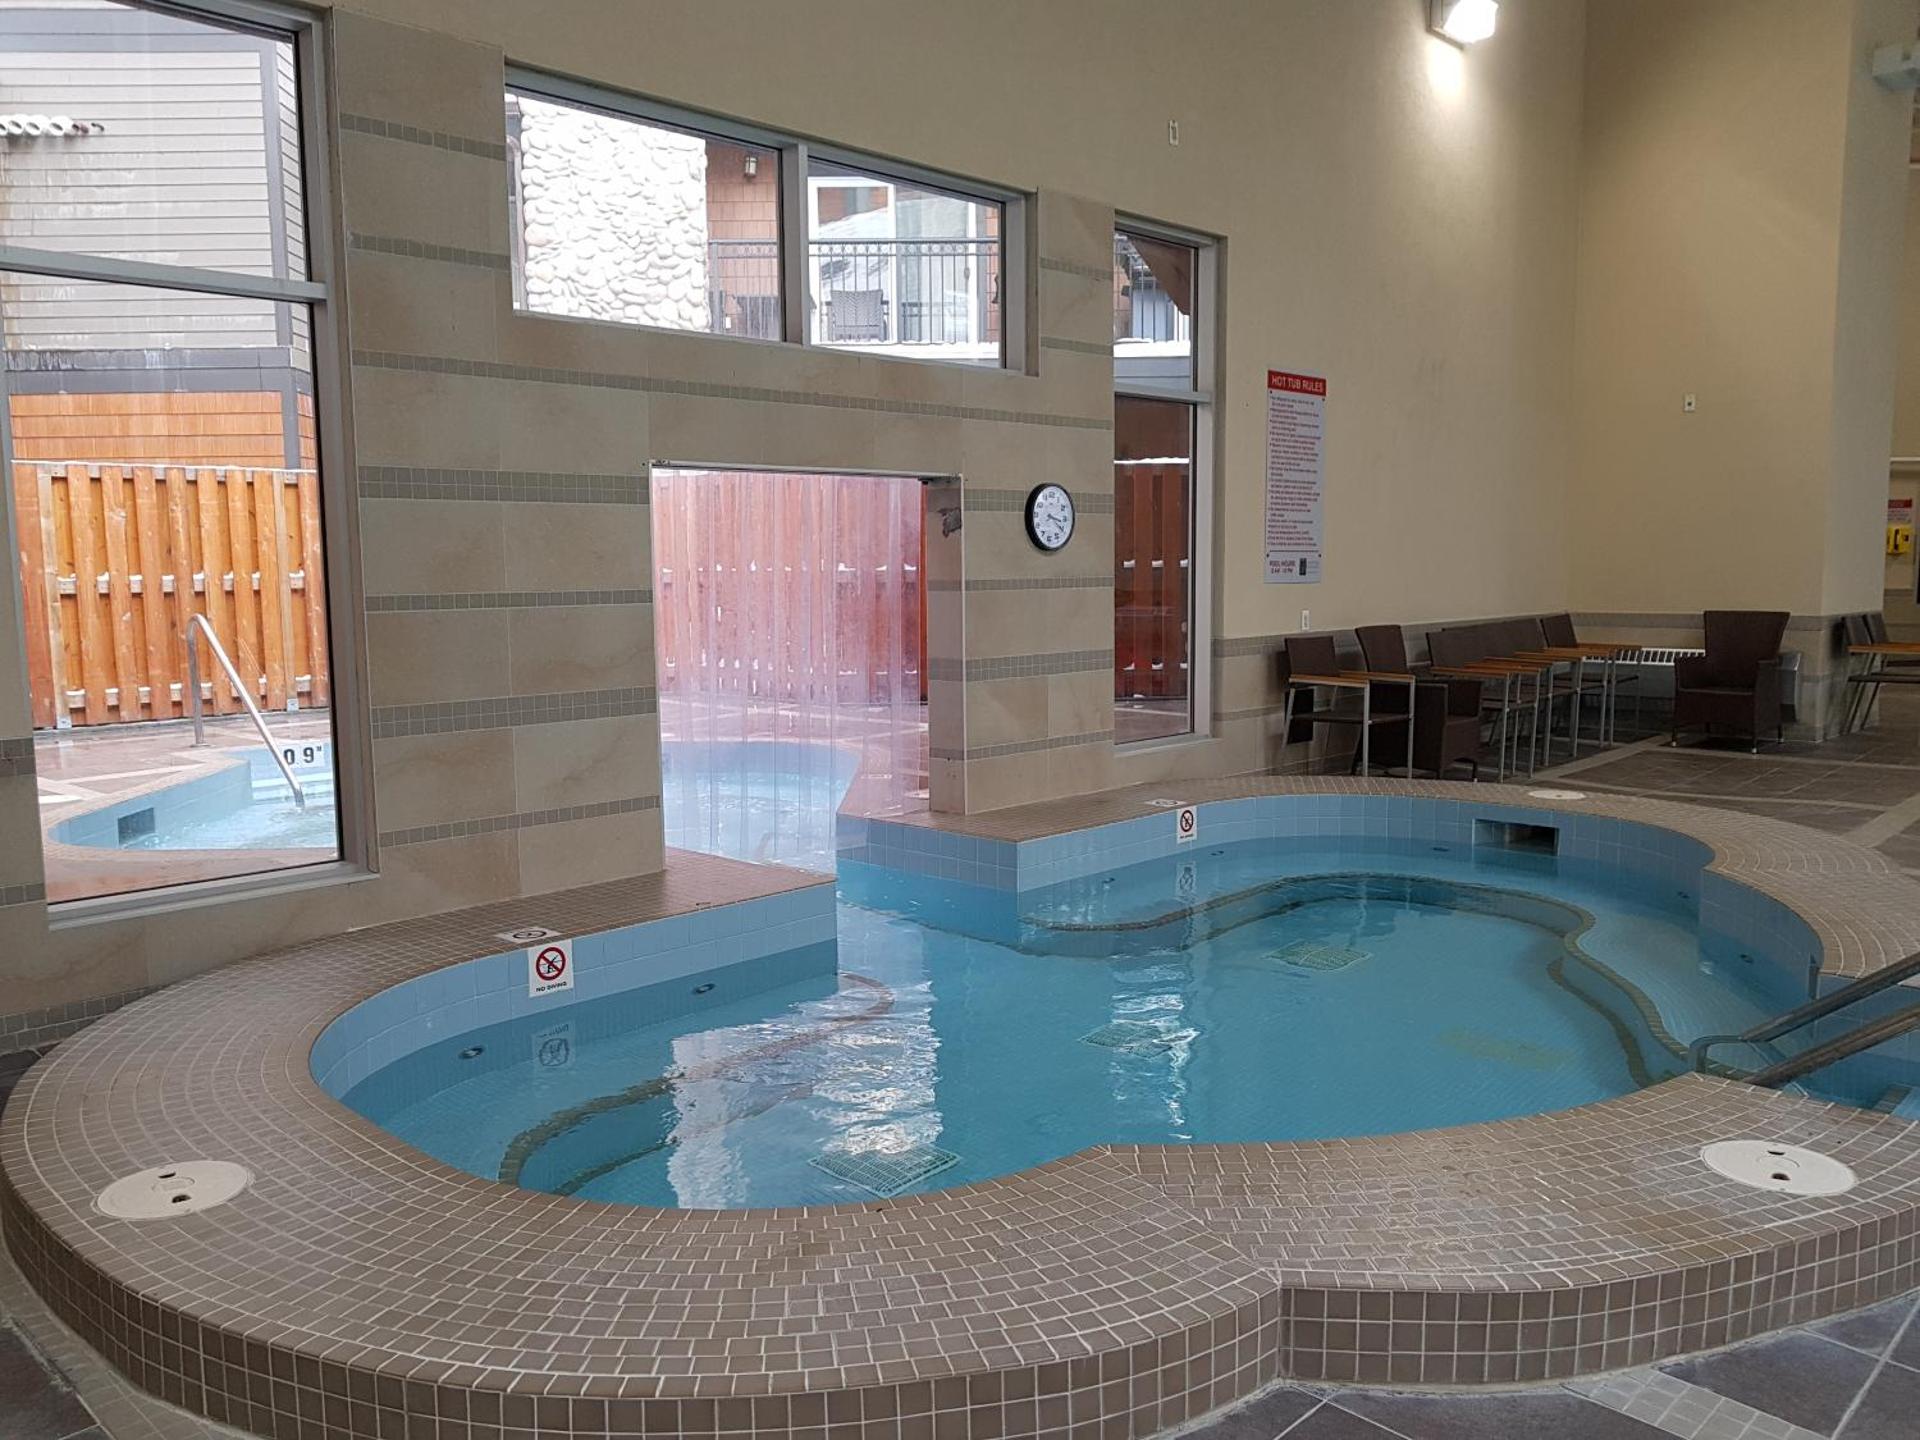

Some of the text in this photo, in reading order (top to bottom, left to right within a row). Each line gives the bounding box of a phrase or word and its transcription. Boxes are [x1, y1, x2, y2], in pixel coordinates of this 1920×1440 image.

[1271, 374, 1323, 392] HOT TUB RULES
[547, 981, 567, 990] DIVING
